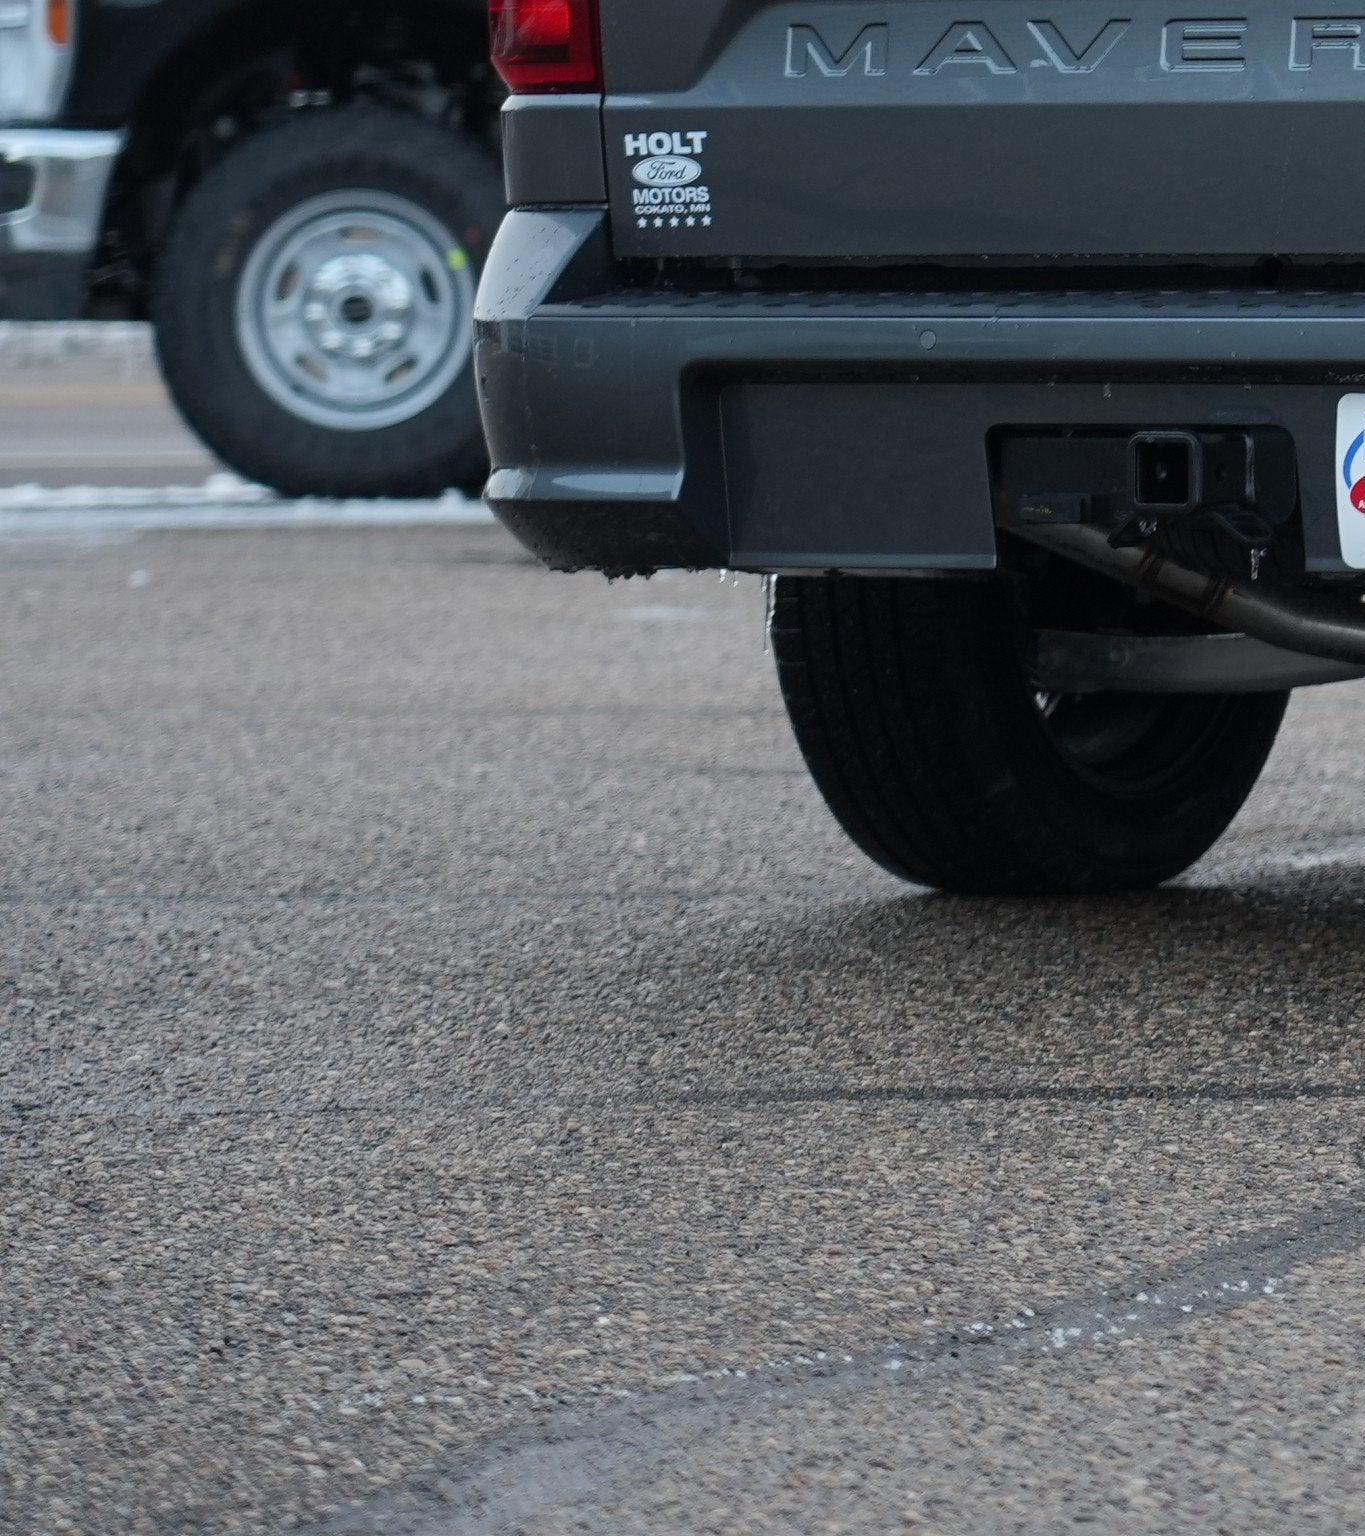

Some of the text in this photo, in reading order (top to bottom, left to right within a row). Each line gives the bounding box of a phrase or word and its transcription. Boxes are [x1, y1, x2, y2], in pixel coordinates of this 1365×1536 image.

[624, 131, 707, 156] HOLT
[647, 161, 688, 180] Ford
[632, 186, 710, 204] MOTORS
[635, 203, 711, 215] COKATO, MN
